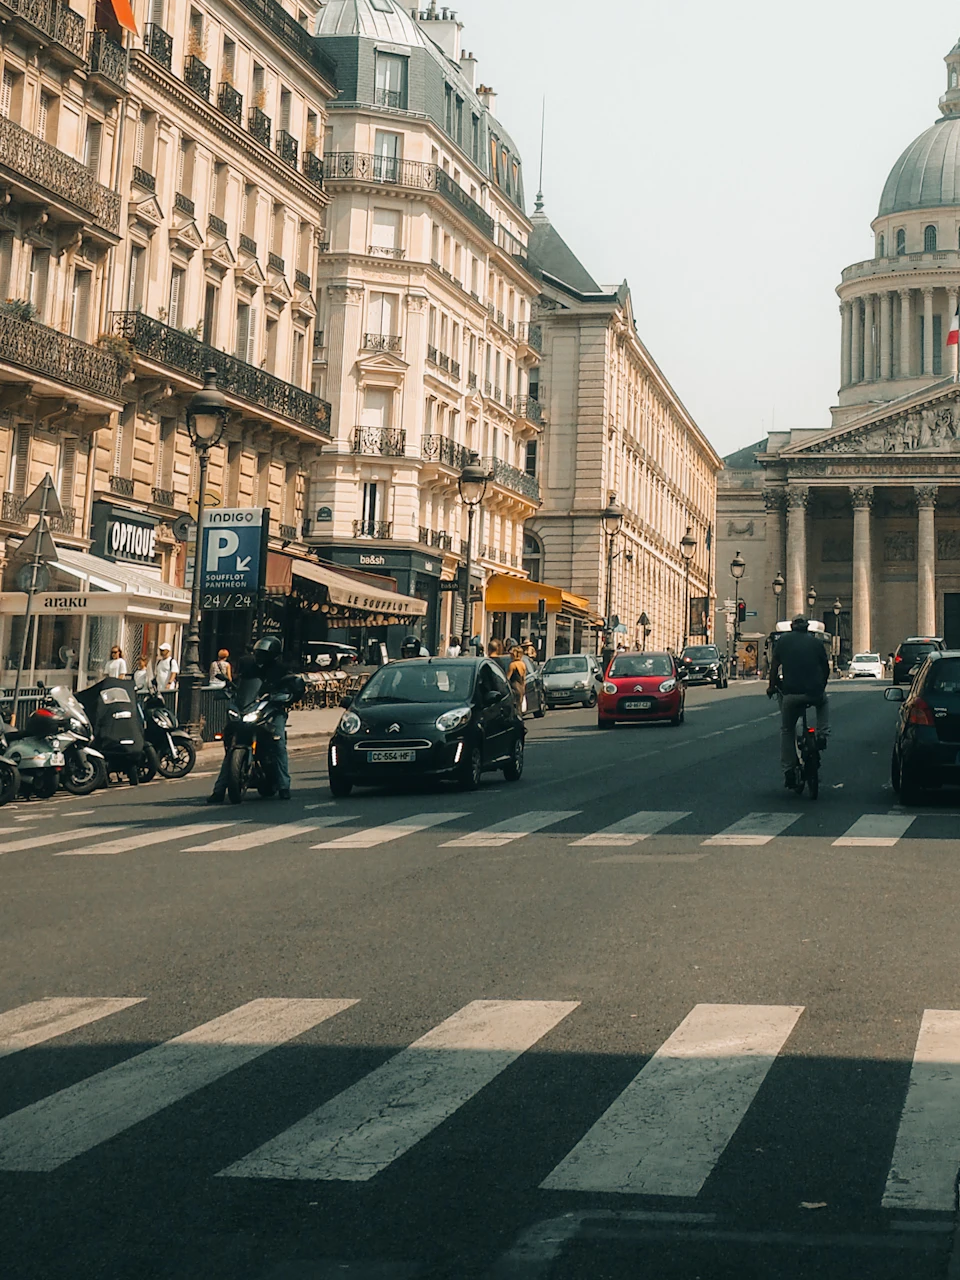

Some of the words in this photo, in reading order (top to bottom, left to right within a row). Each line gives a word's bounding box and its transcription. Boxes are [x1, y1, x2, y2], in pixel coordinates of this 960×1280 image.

[209, 512, 254, 523] INDIGO
[111, 521, 157, 558] OPTIQUE
[206, 529, 240, 572] P
[360, 554, 385, 565] ba&sh
[205, 573, 245, 581] SOUFFLOT
[44, 597, 88, 607] araku
[203, 594, 221, 608] 24
[234, 593, 251, 608] 24
[347, 595, 358, 605] LE
[363, 598, 409, 612] SOUFFLOT
